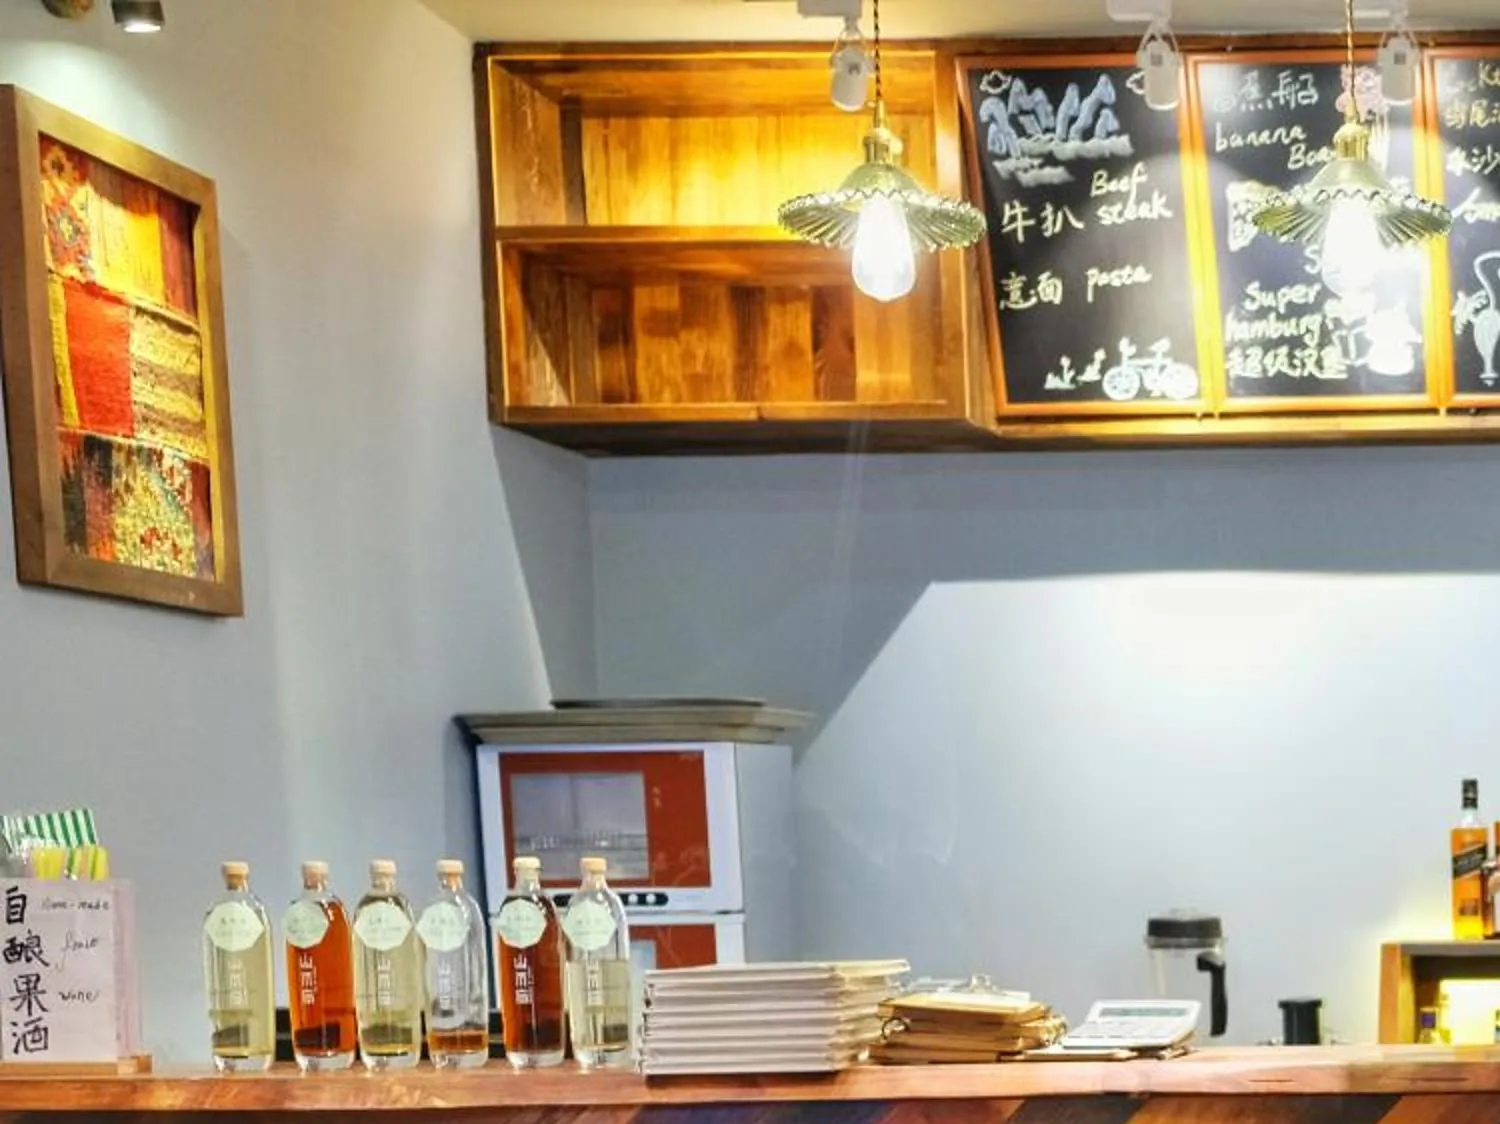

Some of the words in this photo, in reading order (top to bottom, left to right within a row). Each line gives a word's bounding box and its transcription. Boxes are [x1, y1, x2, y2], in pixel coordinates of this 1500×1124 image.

[1214, 121, 1307, 152] banana
[1286, 143, 1347, 170] Boa
[1090, 161, 1149, 198] Beef
[1001, 200, 1085, 243] 牛扒
[1096, 190, 1174, 227] steak
[1000, 271, 1063, 309] 意面
[2, 885, 51, 1056] 自酿果酒
